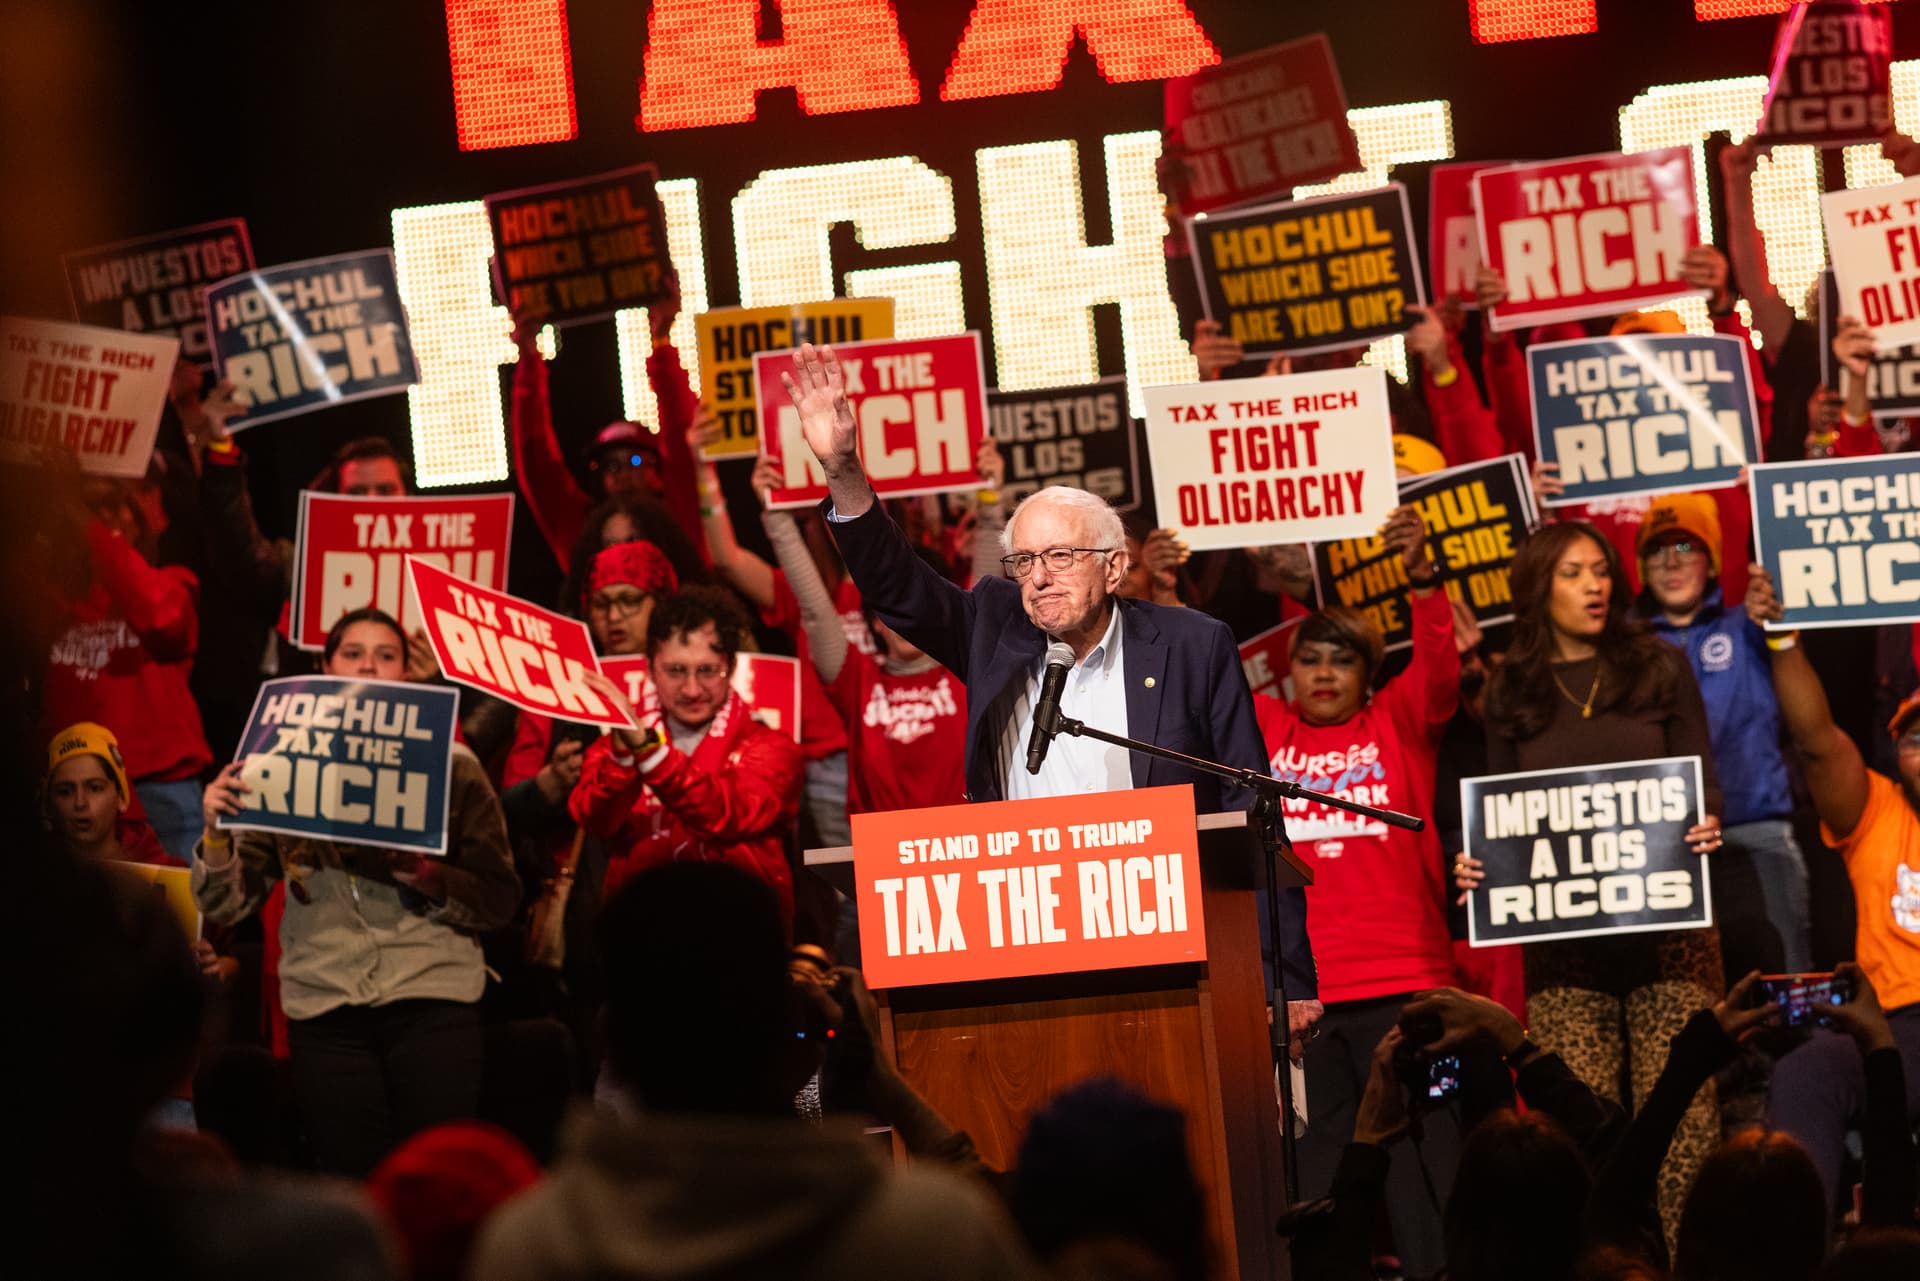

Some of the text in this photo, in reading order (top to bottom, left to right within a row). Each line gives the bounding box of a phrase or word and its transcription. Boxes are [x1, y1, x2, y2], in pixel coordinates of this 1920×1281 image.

[1802, 56, 1869, 93] LOS
[1766, 94, 1890, 134] ICOS
[1522, 164, 1650, 214] TAX THE
[500, 186, 648, 244] HOCHUL
[1211, 206, 1392, 270] HOCHUL
[1845, 204, 1892, 228] TAX
[78, 235, 243, 305] IMPUESTOS
[1499, 197, 1686, 304] RICH
[214, 268, 384, 332] HOCHUL
[1219, 260, 1323, 306] WHICH
[1327, 248, 1400, 292] SIDE
[122, 299, 144, 331] A
[305, 302, 363, 332] THE
[1230, 288, 1404, 344] ARE YOU ON?
[49, 342, 92, 362] THE
[100, 351, 155, 370] RICH
[225, 322, 401, 407] RICH
[872, 352, 935, 392] THE
[1545, 349, 1734, 398] HOCHUL
[22, 360, 120, 412] FIGHT
[1168, 391, 1359, 424] TAX THE RICH
[1575, 392, 1641, 422] TAX
[778, 387, 971, 490] RCH
[991, 393, 1119, 444] UESTOS
[1012, 438, 1084, 479] LOS
[1208, 420, 1321, 475] FIGHT
[1552, 408, 1748, 486] RICH
[1177, 470, 1365, 528] OLIGARCHY
[1772, 472, 1920, 519] HOCH
[353, 512, 477, 549] TAX THE
[1328, 479, 1508, 577] HOHUL
[1441, 523, 1517, 571] SIDE
[1805, 511, 1920, 545] TAX TH
[1467, 567, 1512, 609] ON
[1778, 540, 1920, 609] RIC
[447, 584, 558, 650] TAX THE
[1242, 651, 1274, 689] HE
[260, 692, 433, 741] HOCHUL
[276, 727, 403, 766] TAX THE
[238, 752, 430, 833] RICH
[1483, 775, 1689, 841] IMPUESTOS
[898, 818, 1154, 865] STAND UP TO TRUMP
[1529, 829, 1648, 880] A LOS
[874, 852, 1189, 958] TAX THE RICH
[1488, 869, 1694, 926] RICOS
